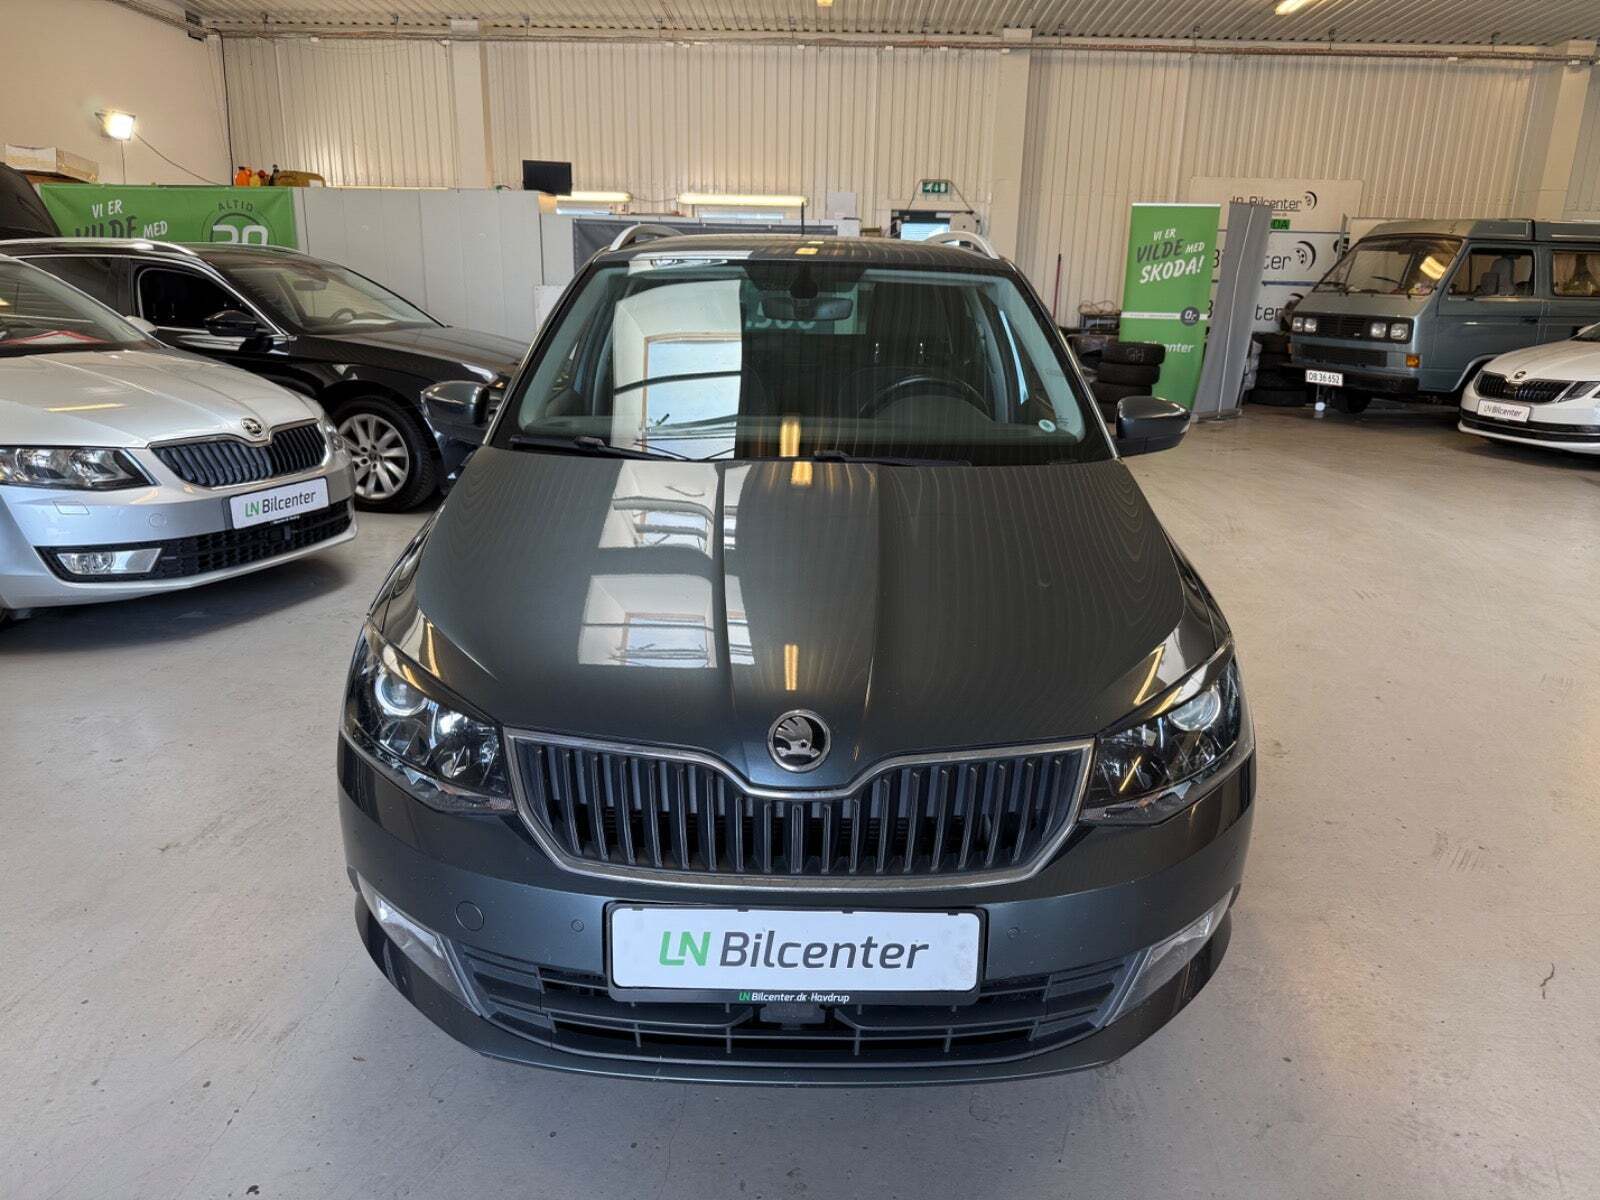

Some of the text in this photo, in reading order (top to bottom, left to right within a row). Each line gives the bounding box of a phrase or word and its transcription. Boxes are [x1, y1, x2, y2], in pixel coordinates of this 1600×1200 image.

[91, 199, 123, 219] VI ER
[218, 200, 254, 212] ALTID
[143, 220, 168, 239] MED
[1153, 228, 1176, 241] VI ER
[1136, 238, 1205, 263] VILDE MED
[1140, 255, 1205, 284] SKODA!
[245, 491, 317, 517] LN Bilcenter
[659, 930, 930, 969] LN Bilcenter
